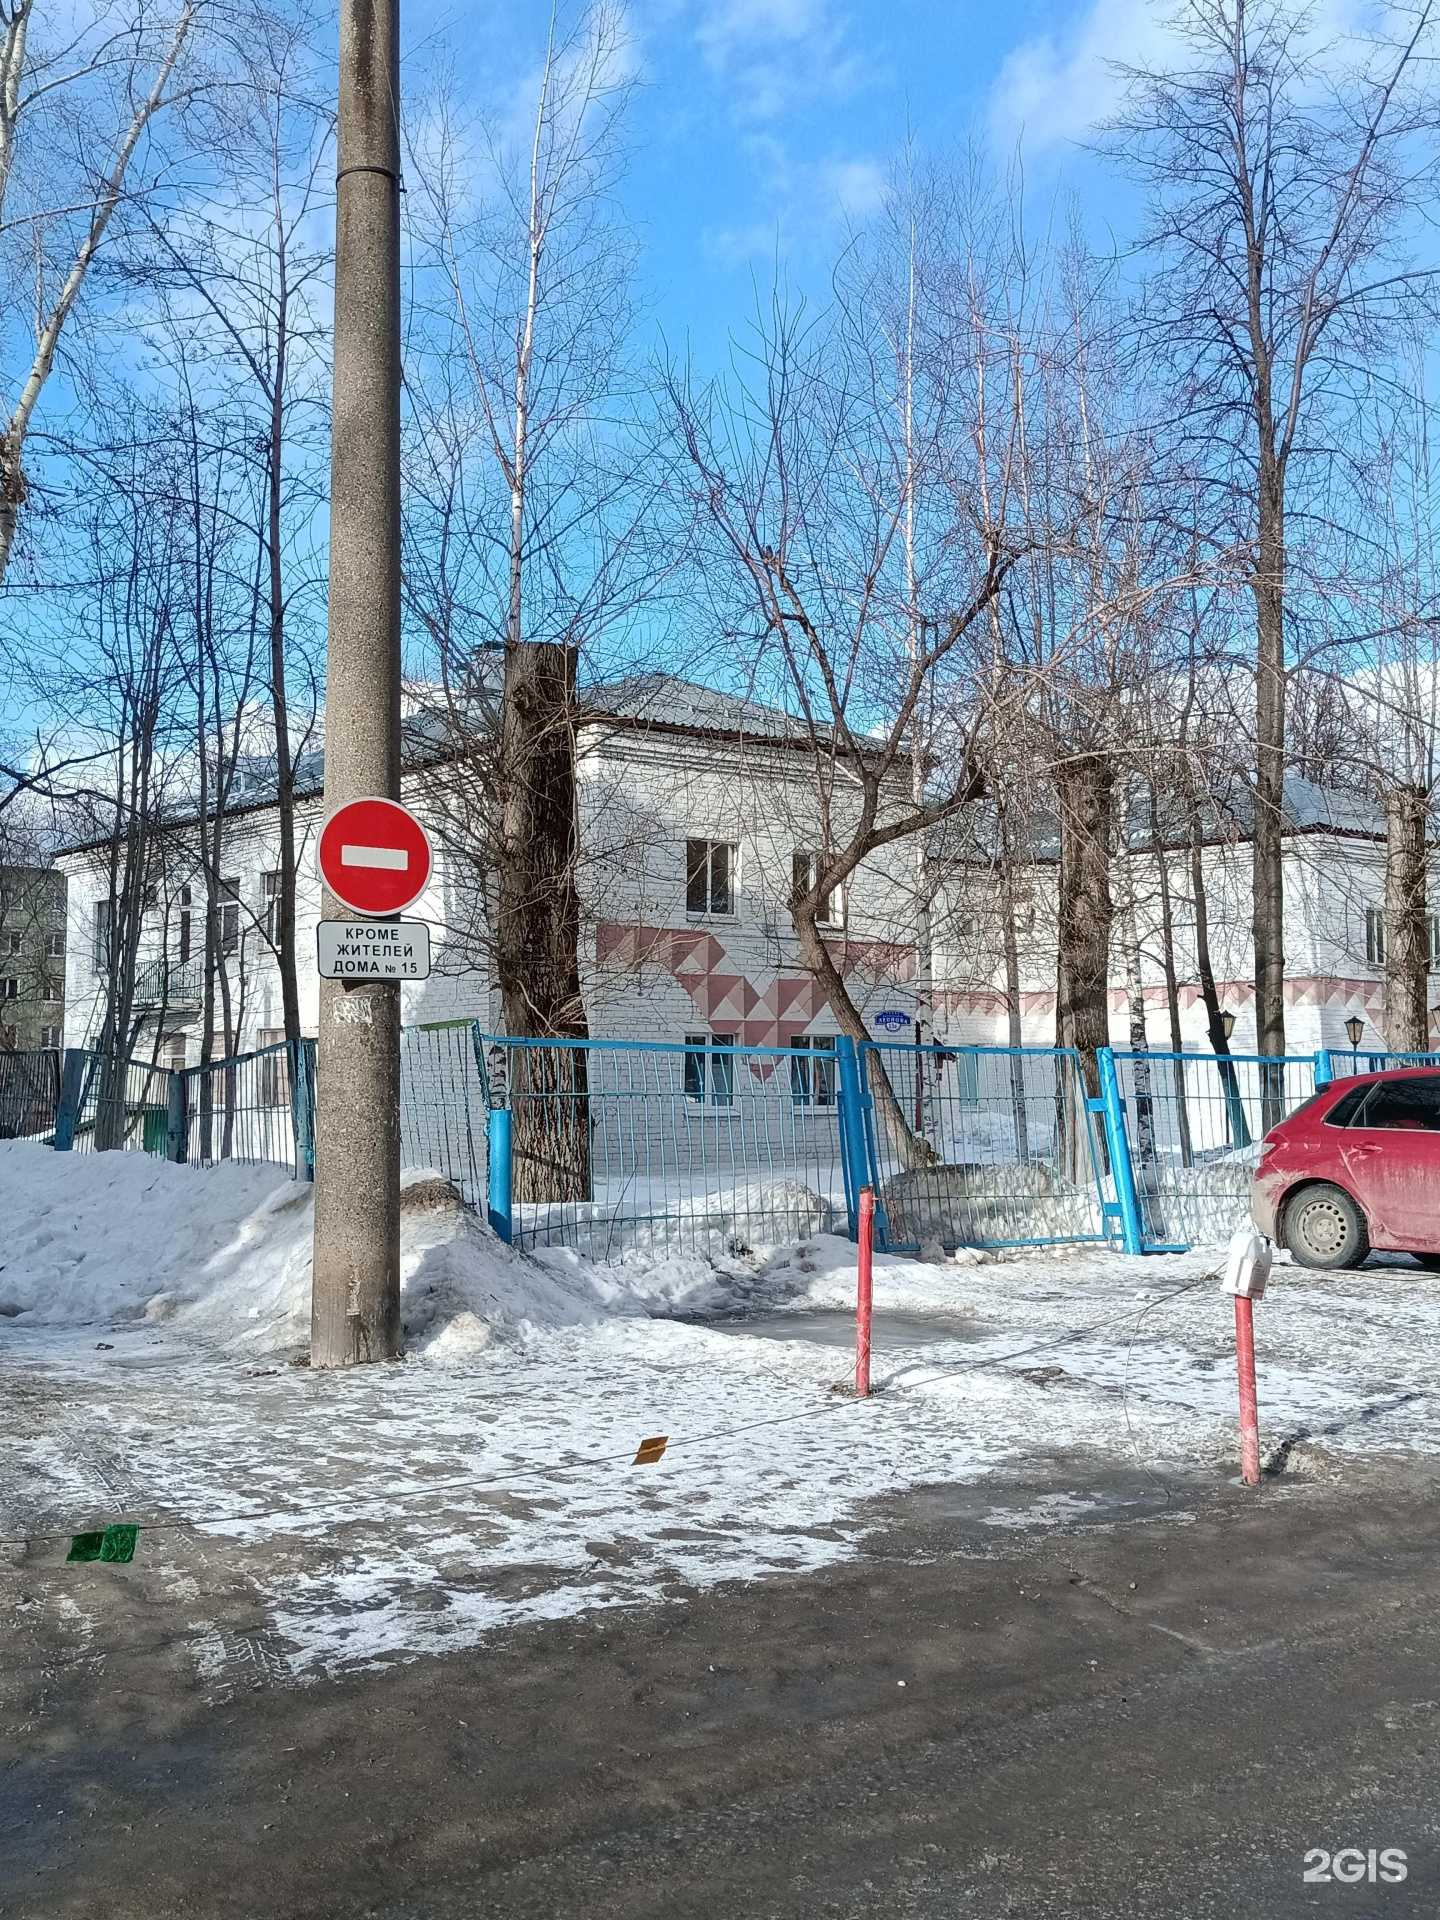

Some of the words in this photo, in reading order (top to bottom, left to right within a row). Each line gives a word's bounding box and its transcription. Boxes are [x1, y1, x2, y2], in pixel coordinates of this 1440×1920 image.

[345, 928, 399, 940] КРОМЕ
[336, 943, 413, 957] ЖИТЕЛЕЙ
[333, 960, 380, 974] ДОМА
[401, 962, 418, 974] 15
